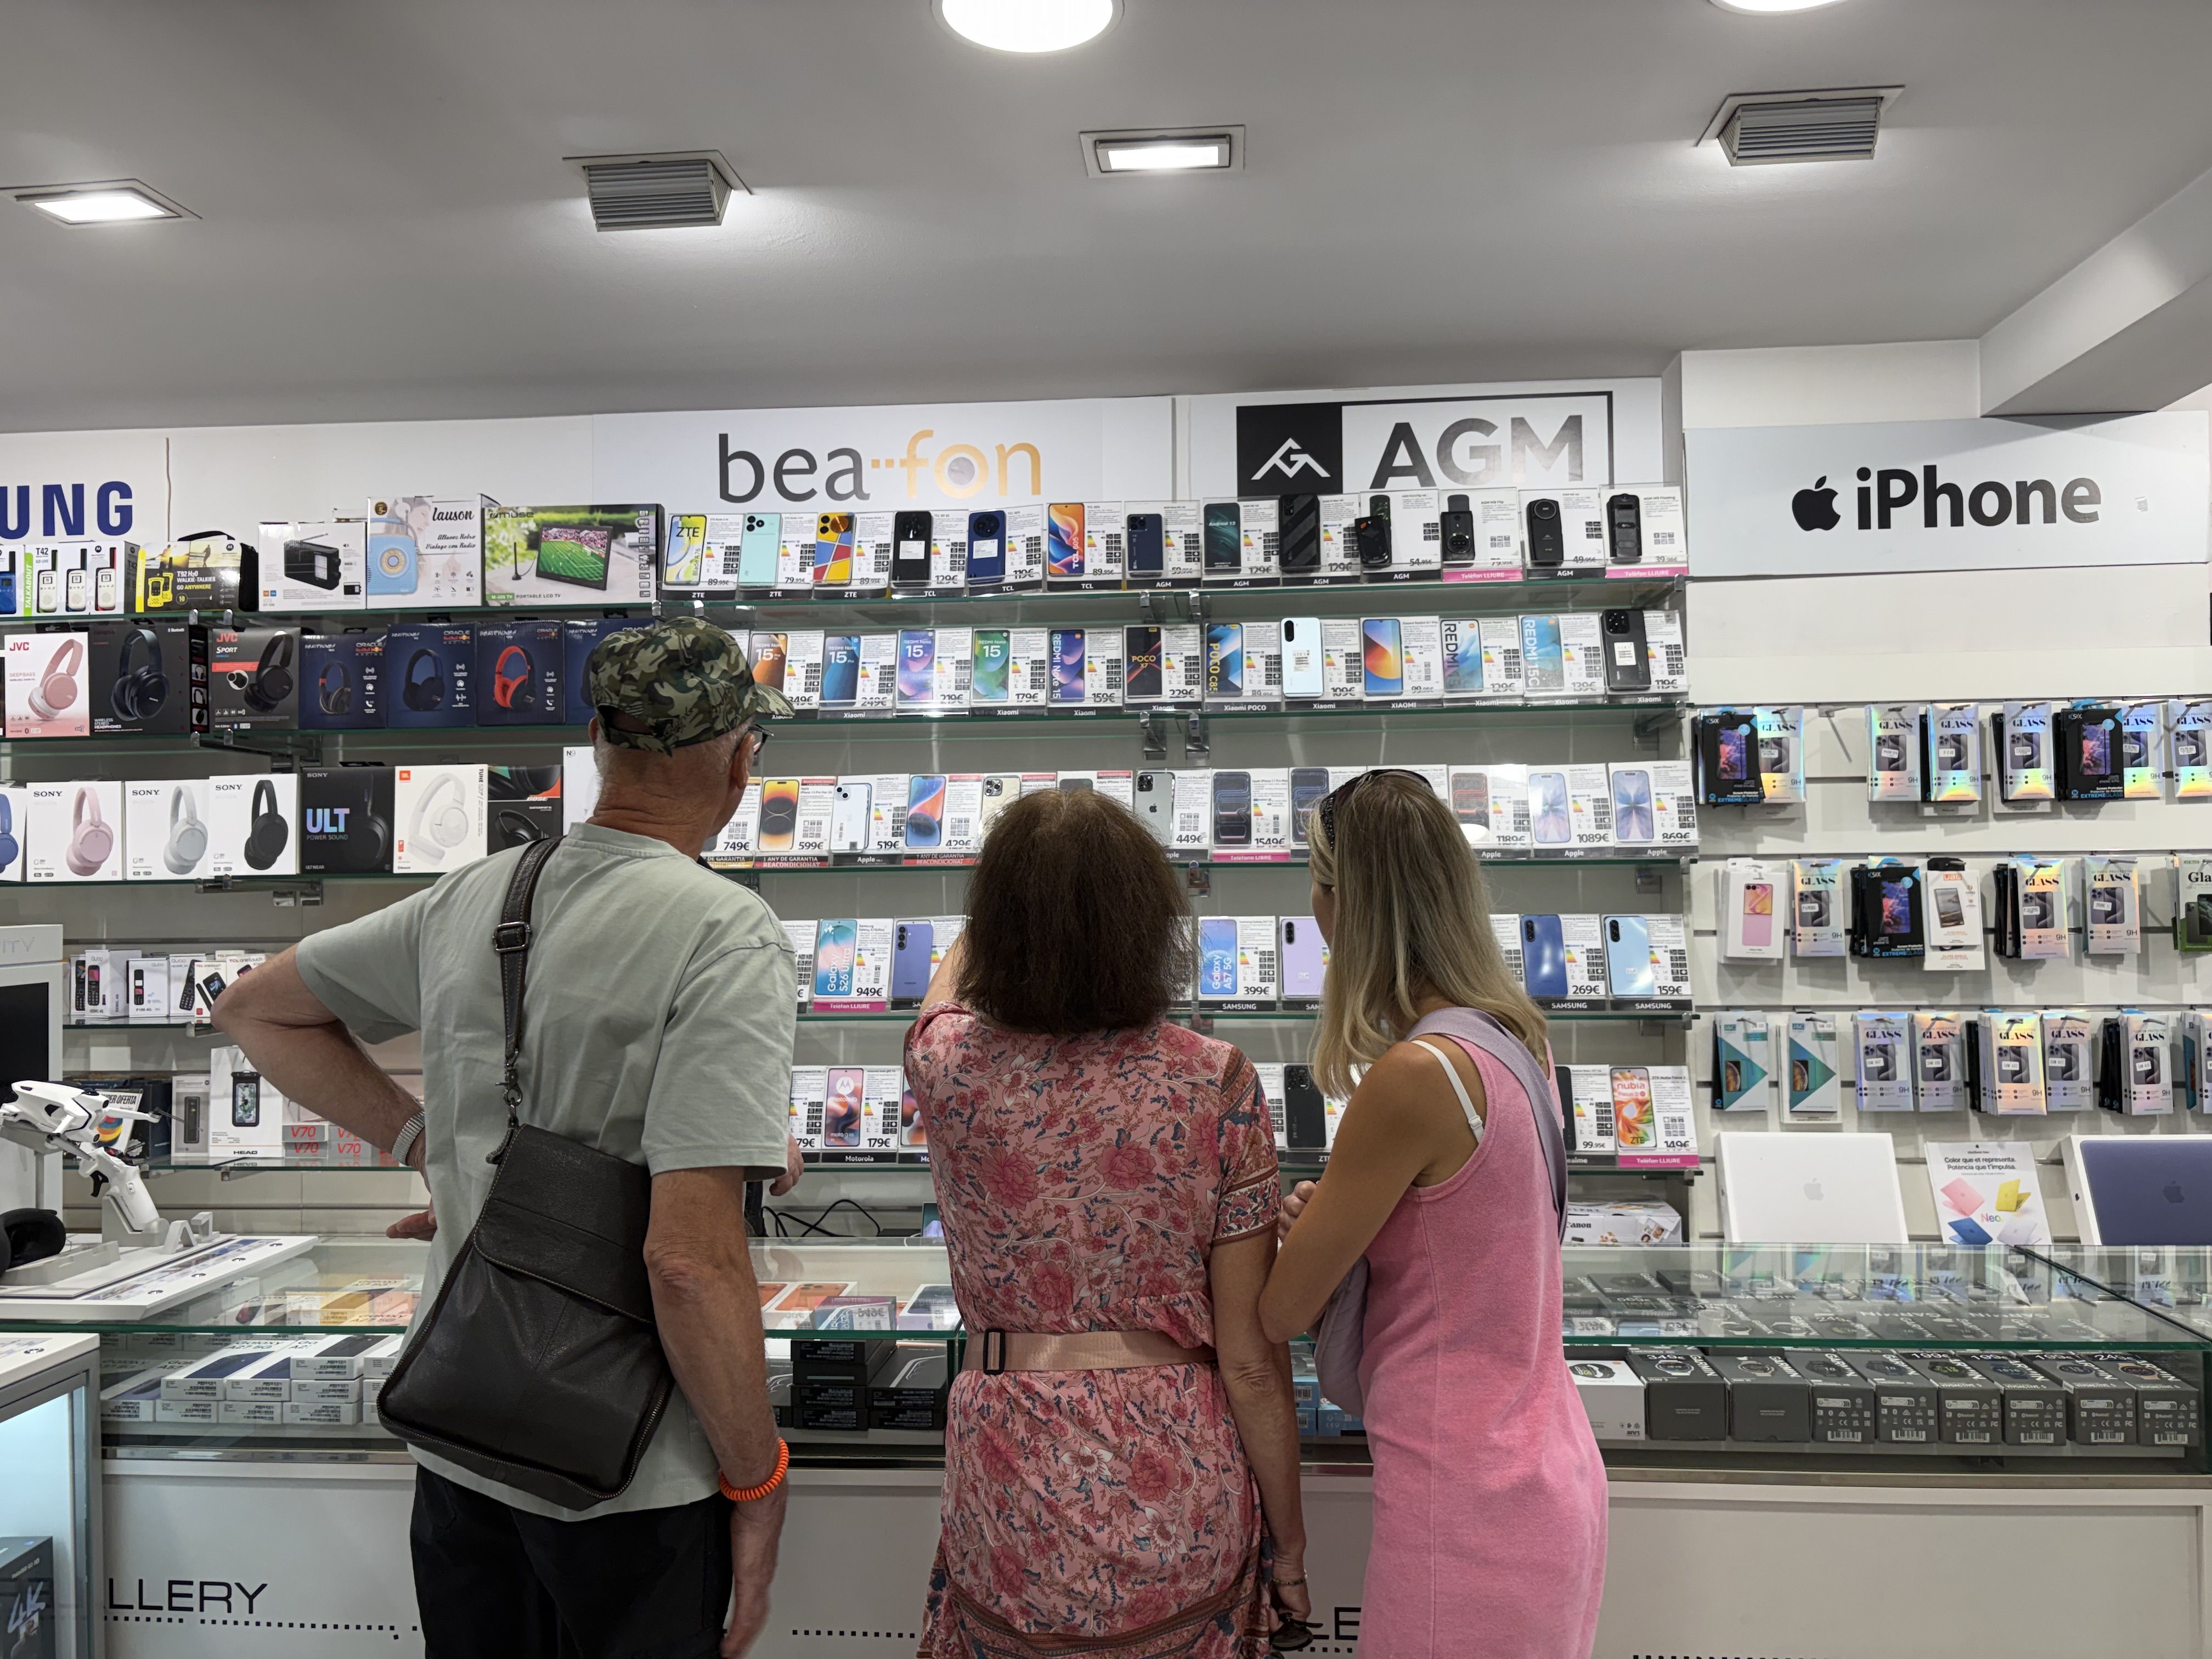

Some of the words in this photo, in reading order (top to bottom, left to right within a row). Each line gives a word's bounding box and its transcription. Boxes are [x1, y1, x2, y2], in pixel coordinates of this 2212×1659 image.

[1369, 414, 1583, 489] AGM
[1857, 465, 2102, 530] iPhone
[432, 507, 474, 522] lauson
[676, 527, 699, 537] ZTE
[24, 565, 33, 608] TALKABOUT
[216, 633, 238, 642] JVC
[1523, 619, 1536, 659] REDMI
[10, 642, 30, 651] JVC
[905, 645, 923, 657] 15
[983, 645, 1001, 657] 15
[1052, 634, 1061, 664] REDMI
[1444, 623, 1459, 668] REDMI
[755, 649, 774, 661] 15
[829, 652, 847, 663] 15
[1209, 643, 1220, 674] POCO
[1052, 665, 1061, 687] Note
[1528, 664, 1540, 686] 15C
[1052, 689, 1061, 698] 15
[1091, 693, 1115, 702] 159€
[1941, 719, 1973, 728] GLASS
[2013, 718, 2046, 727] GLASS
[2176, 717, 2210, 725] GLASS
[306, 808, 349, 832] ULT
[1176, 835, 1203, 843] 449€
[1577, 833, 1610, 843] 1089€
[724, 842, 749, 850] 749€
[798, 842, 824, 850] 599€
[877, 840, 899, 849] 519€
[2025, 878, 2059, 886] GLASS
[2094, 873, 2130, 882] GLASS
[840, 948, 850, 972] Ultra
[1224, 958, 1232, 969] 5G
[827, 954, 839, 992] Galaxy
[1212, 955, 1222, 989] Galaxy
[839, 974, 848, 991] S26
[1223, 970, 1232, 989] A57
[856, 988, 882, 996] 949€
[1243, 986, 1269, 995] 399€
[1572, 985, 1600, 995] 269€
[1657, 986, 1683, 995] 159€
[117, 1095, 136, 1104] OFERTA
[290, 1126, 316, 1138] V70
[294, 1142, 319, 1154] V70
[337, 1143, 361, 1155] V70
[867, 1138, 890, 1148] 179€
[1690, 1355, 1718, 1376] GARMIN
[1769, 1356, 1802, 1378] GARMIN
[1825, 1353, 1858, 1376] GARMIN
[1882, 1354, 1920, 1375] GARMIN
[109, 1578, 268, 1613] LLERY
